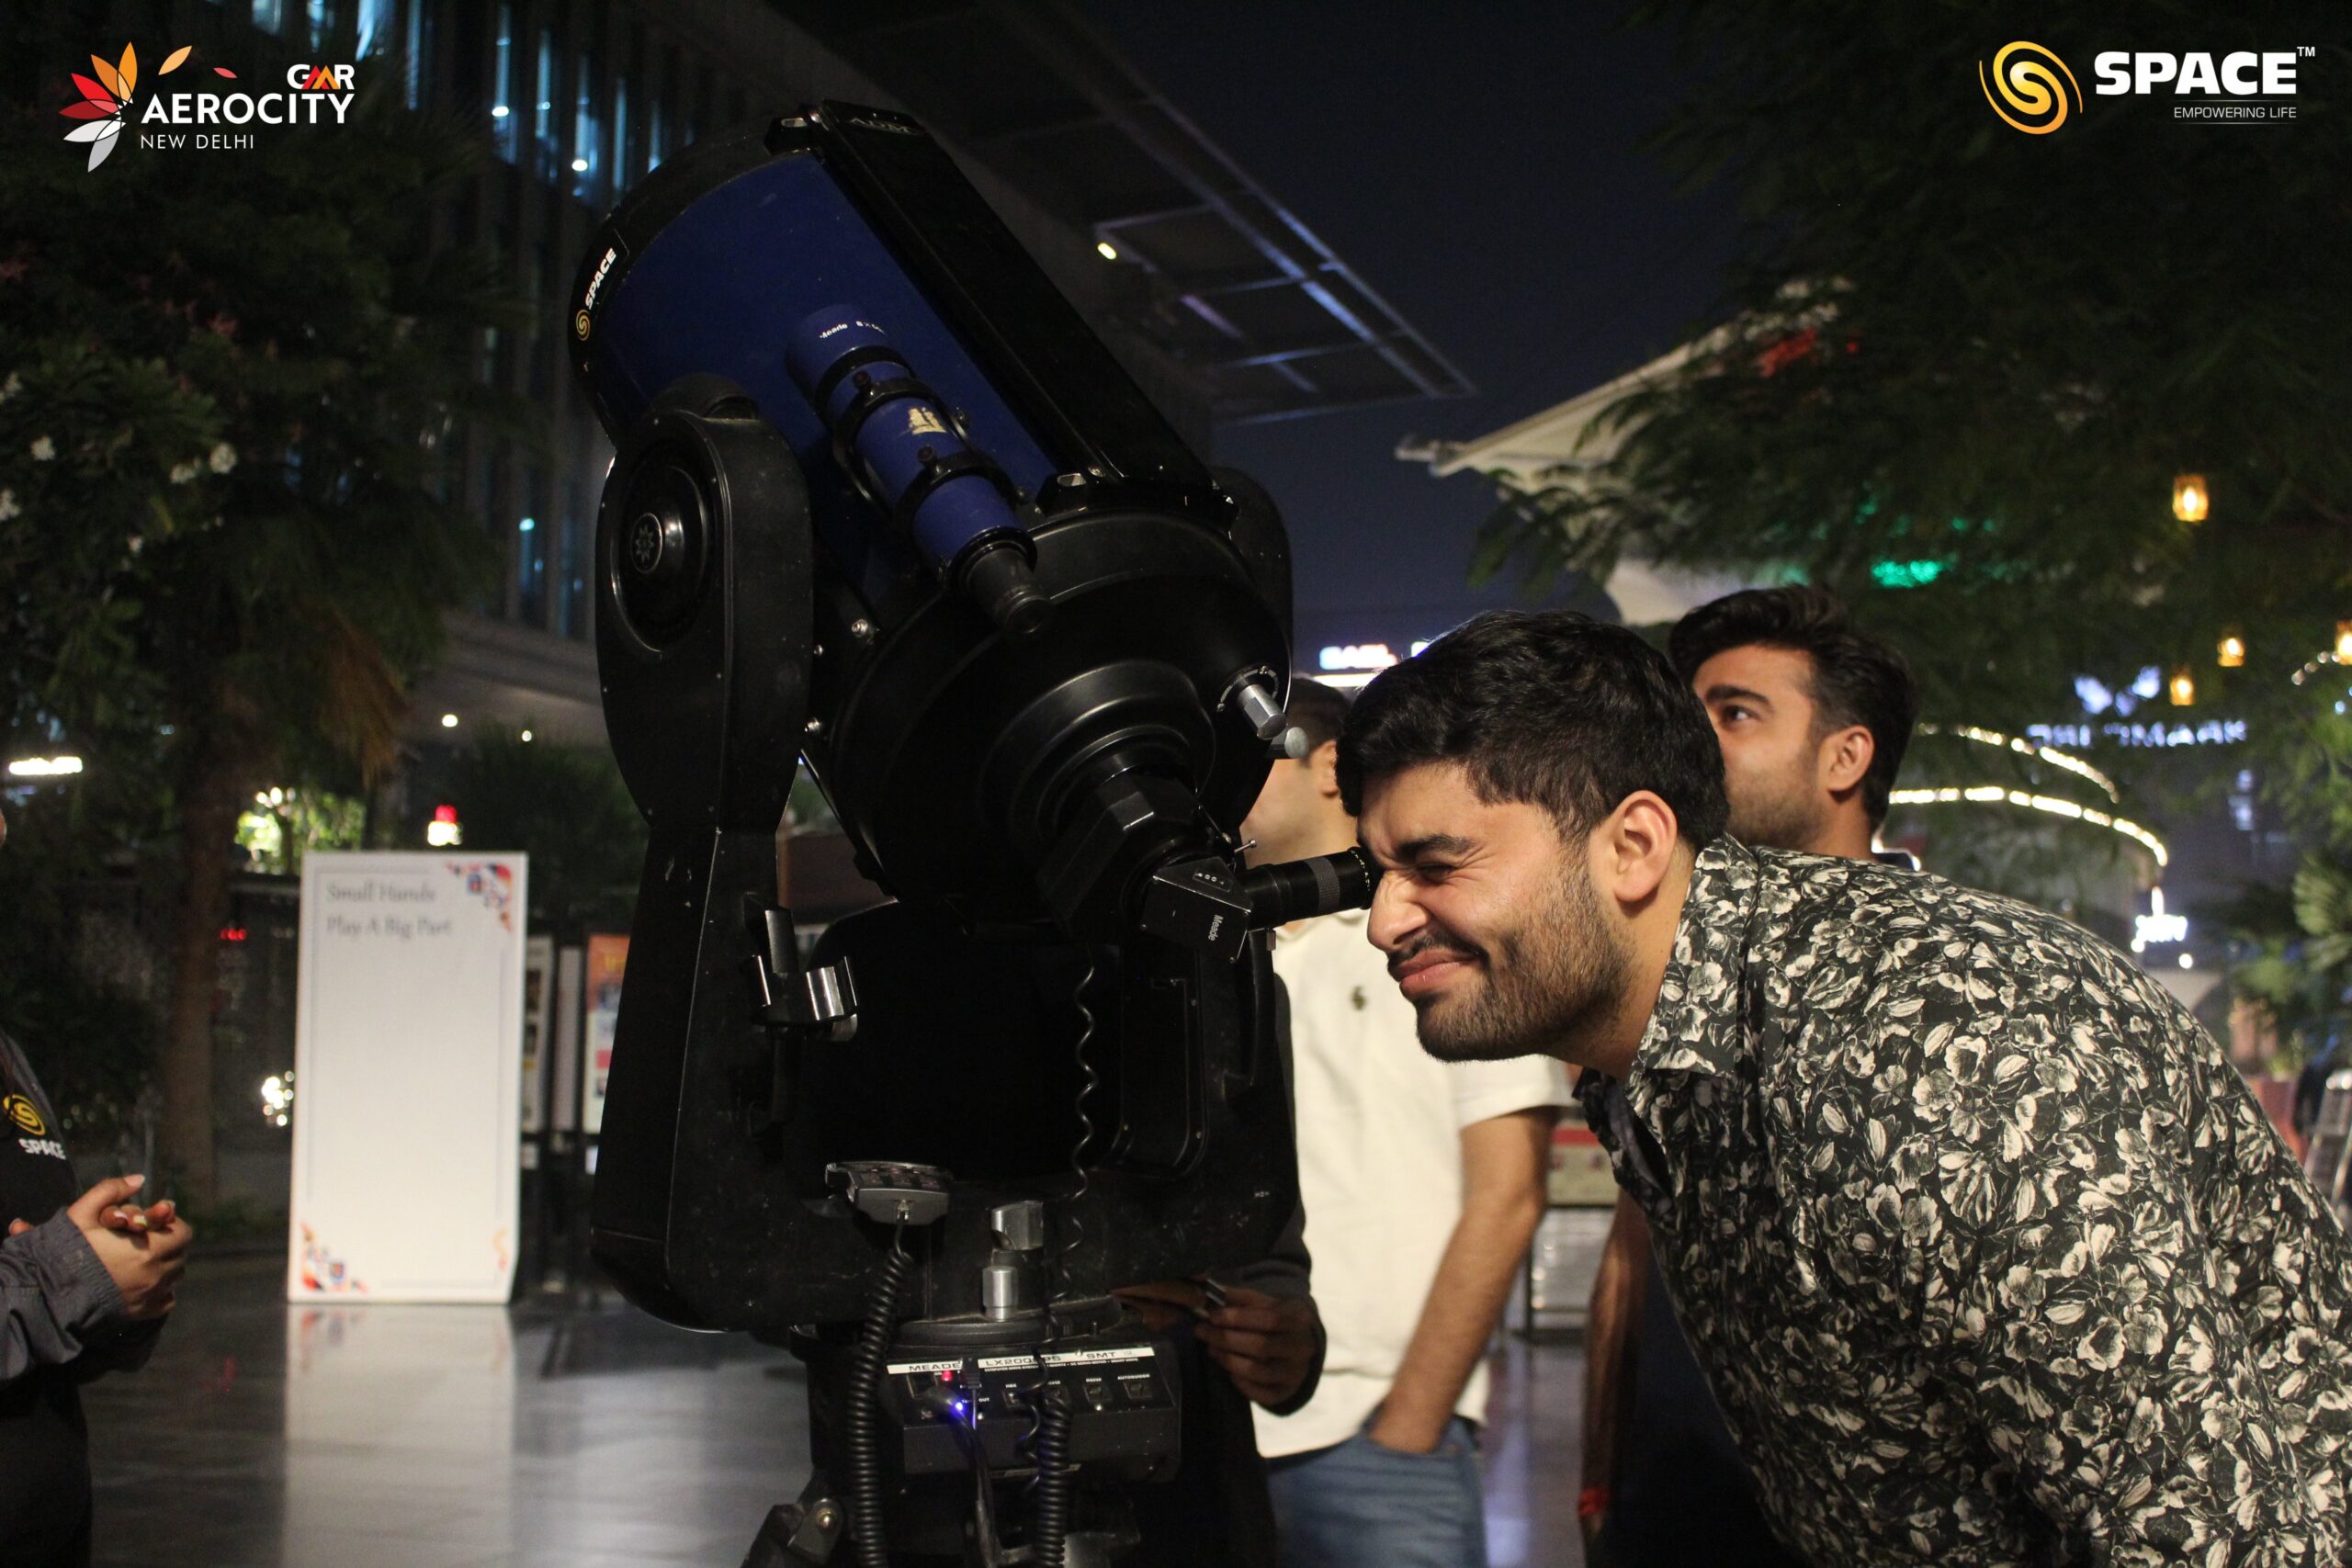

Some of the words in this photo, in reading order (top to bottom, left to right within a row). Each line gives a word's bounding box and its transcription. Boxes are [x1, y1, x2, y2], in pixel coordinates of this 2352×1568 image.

[584, 246, 617, 310] SPACE
[1208, 914, 1224, 941] Meade
[18, 1138, 66, 1160] SPACE
[908, 1362, 962, 1372] MEADE
[985, 1355, 1062, 1367] LX200PS
[1086, 1351, 1116, 1359] SMT
